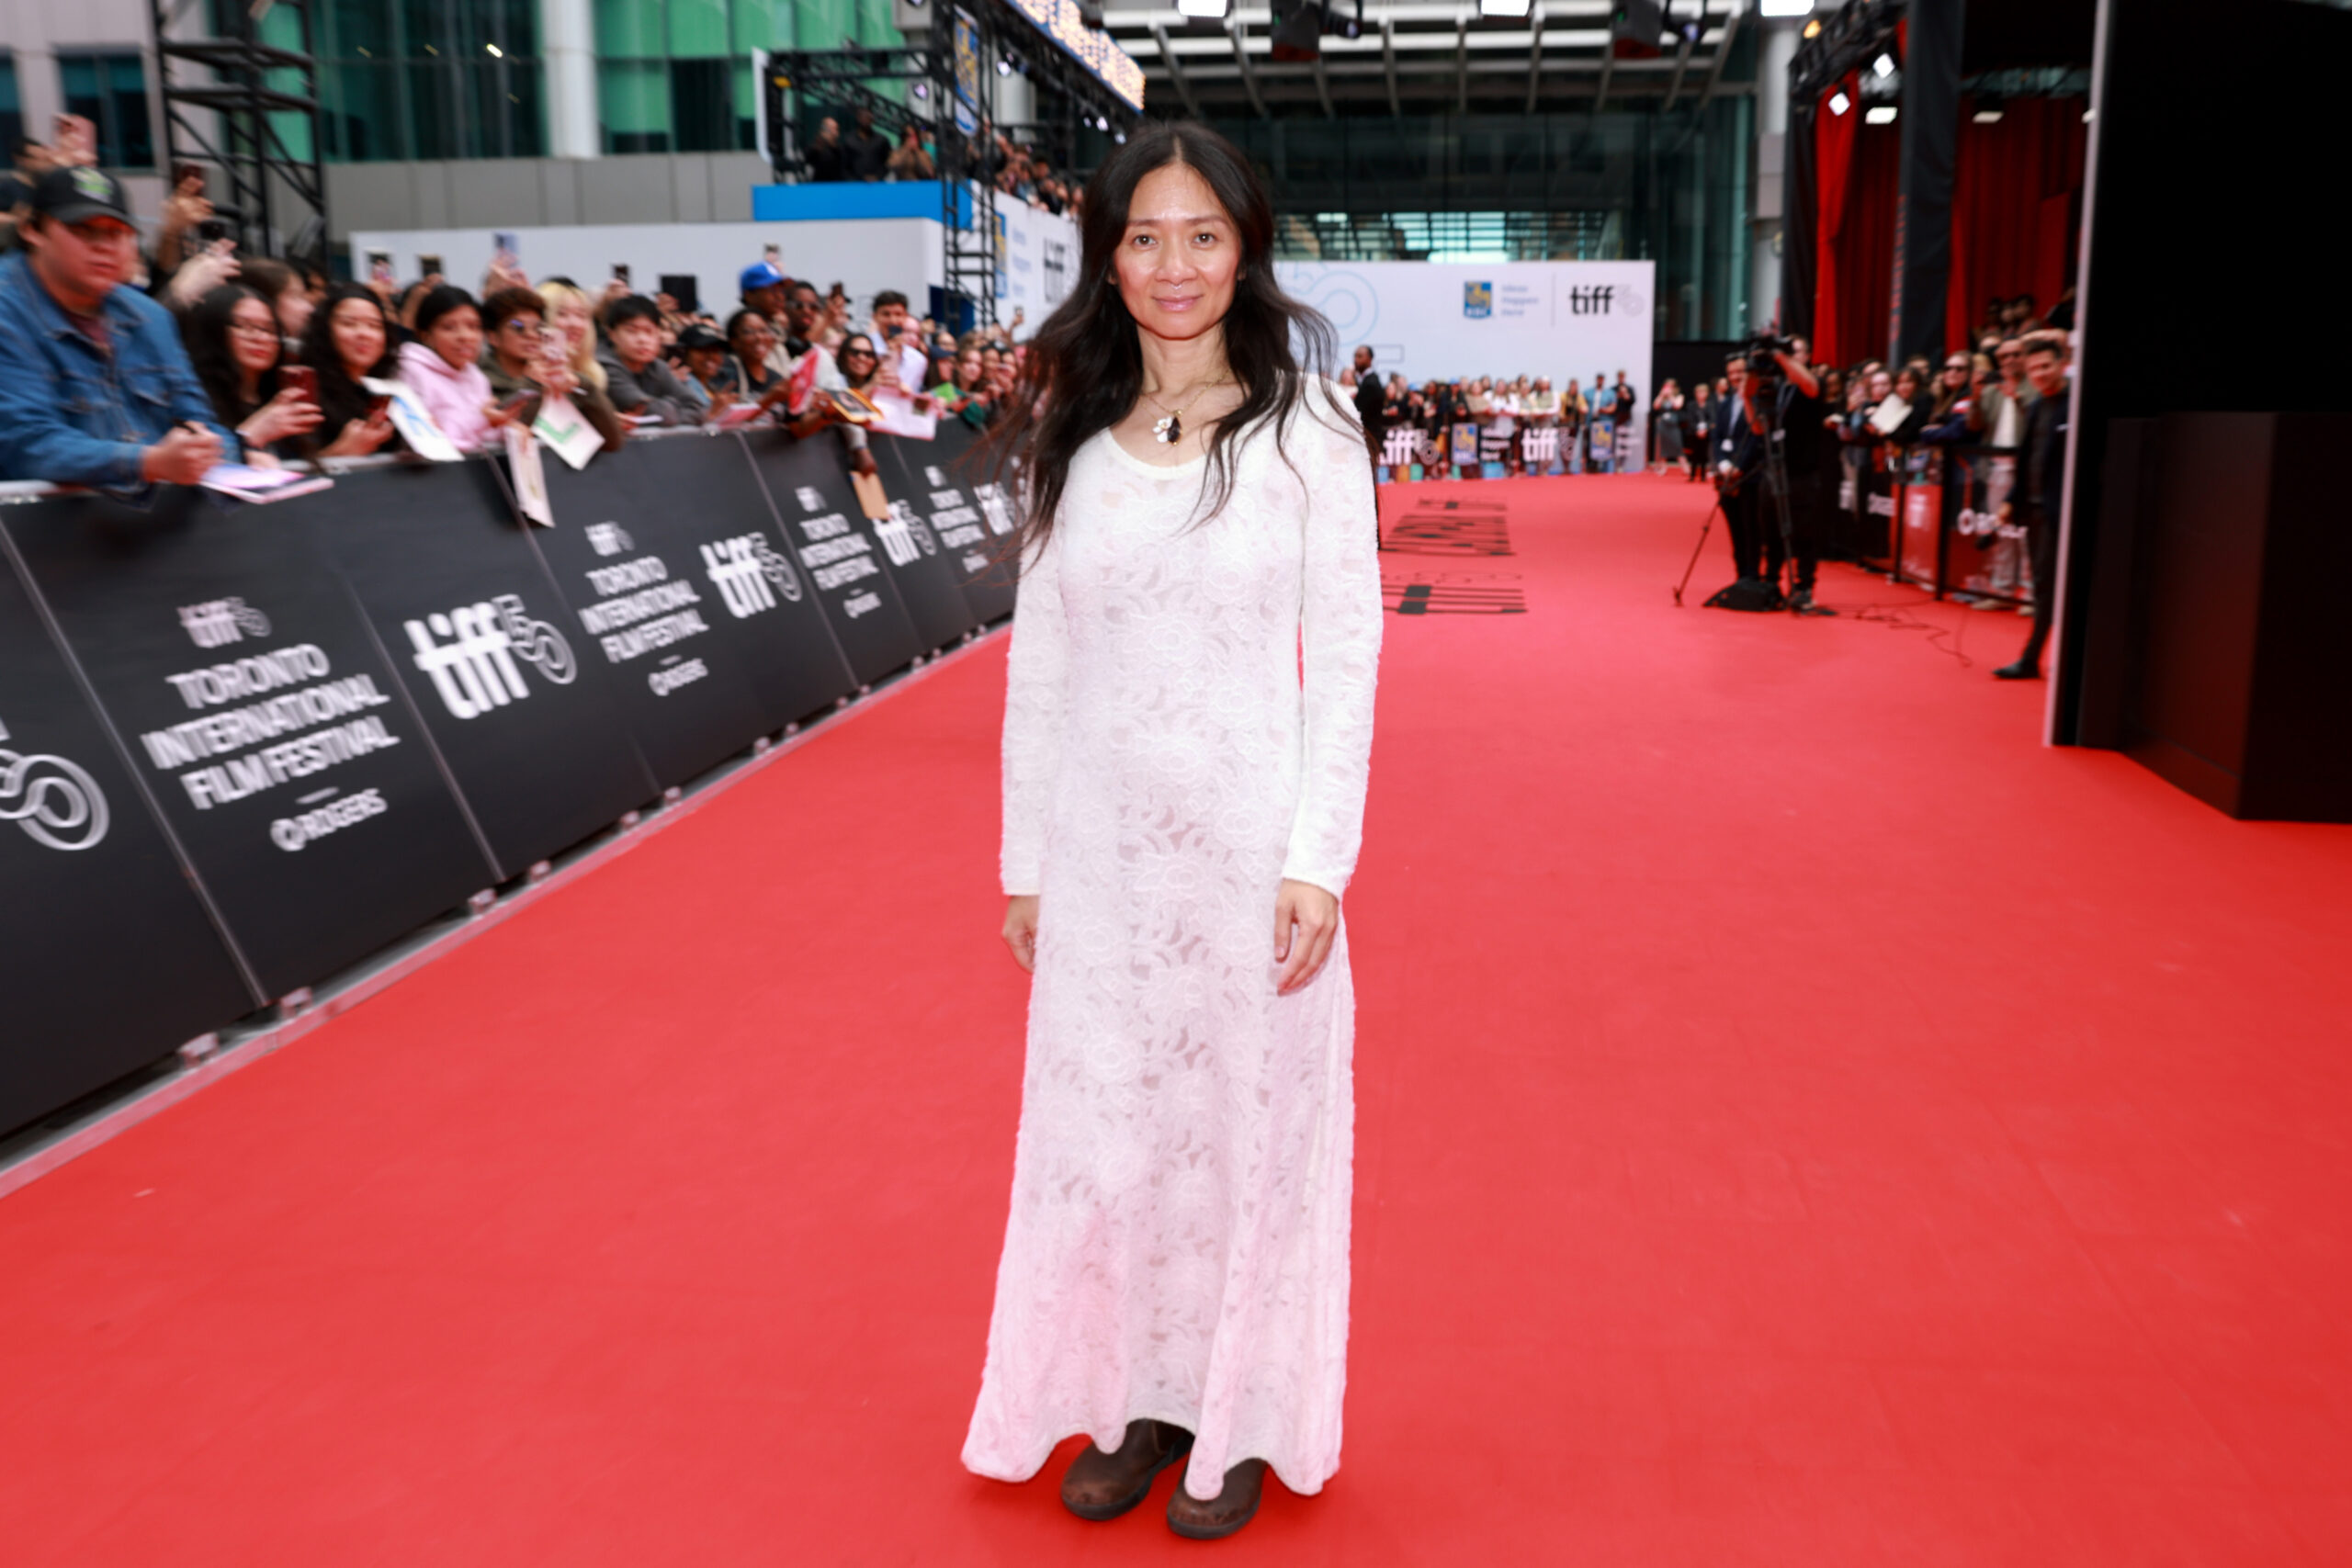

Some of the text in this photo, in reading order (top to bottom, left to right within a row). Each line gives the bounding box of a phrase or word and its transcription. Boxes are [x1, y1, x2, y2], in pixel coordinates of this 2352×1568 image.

[577, 579, 701, 635] INTERNATIONAL
[585, 556, 668, 597] TORONTO
[165, 643, 331, 709] TORONTO
[140, 673, 390, 769] INTERNATIONAL
[180, 716, 401, 810] FILM FESTIVAL
